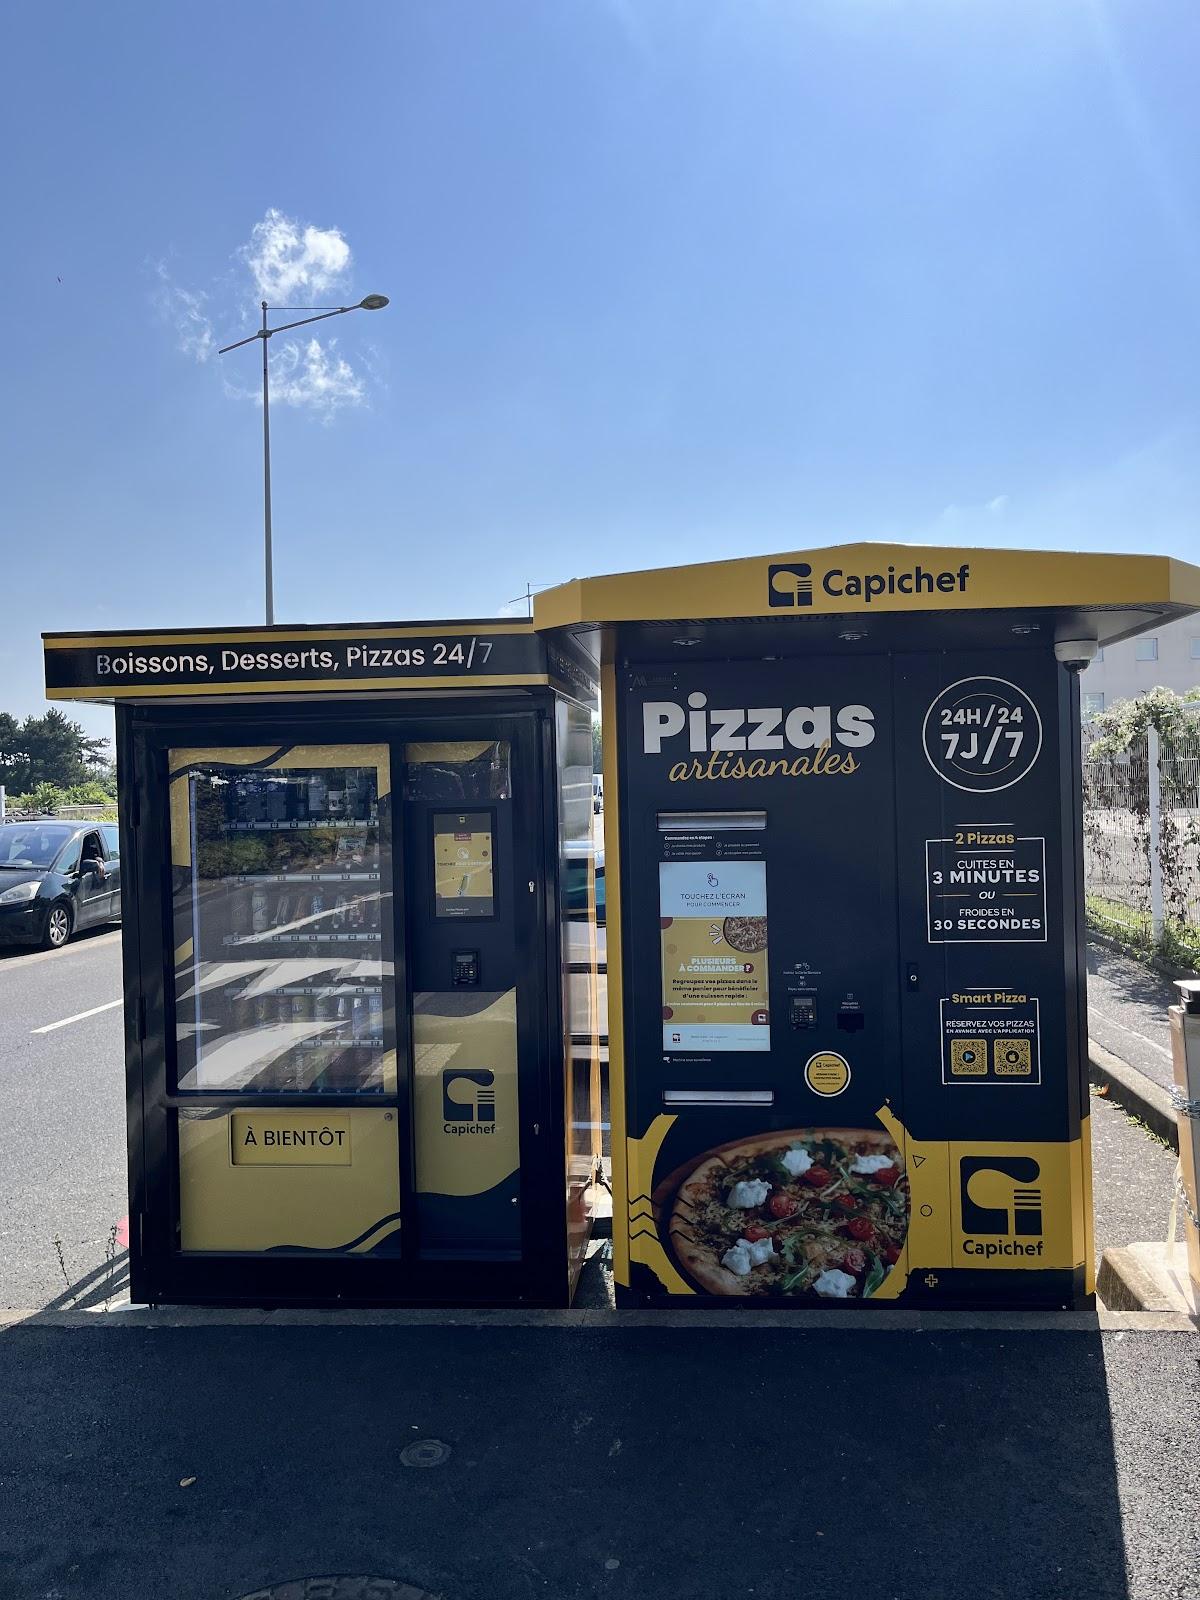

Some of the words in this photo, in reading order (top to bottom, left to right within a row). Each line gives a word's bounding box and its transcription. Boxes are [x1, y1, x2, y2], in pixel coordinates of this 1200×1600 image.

[822, 564, 970, 603] Capichef
[96, 652, 214, 675] Boissons,
[221, 648, 339, 672] Desserts,
[346, 645, 426, 669] Pizzas
[432, 637, 493, 669] 24/7
[642, 691, 876, 754] Pizzas
[940, 703, 1024, 728] 24H/24
[940, 725, 1024, 765] 7J/7
[668, 737, 861, 782] artisanales
[955, 832, 964, 845] 2
[967, 831, 1015, 845] Pizzas
[956, 859, 997, 870] CUITES
[998, 859, 1014, 869] EN
[932, 871, 943, 885] 3
[949, 869, 1040, 884] MINUTES
[978, 890, 996, 900] OU
[959, 908, 1000, 917] FROIDES
[1001, 908, 1015, 916] EN
[933, 919, 953, 931] 30
[957, 918, 1041, 930] SECONDES
[679, 963, 685, 972] À
[951, 993, 992, 1003] Smart
[994, 992, 1027, 1003] Pizza
[987, 1020, 1005, 1028] VOS
[244, 1125, 258, 1147] À
[264, 1126, 346, 1147] BIENTÔT
[443, 1123, 496, 1136] Capichef
[962, 1239, 1044, 1259] Capichef
